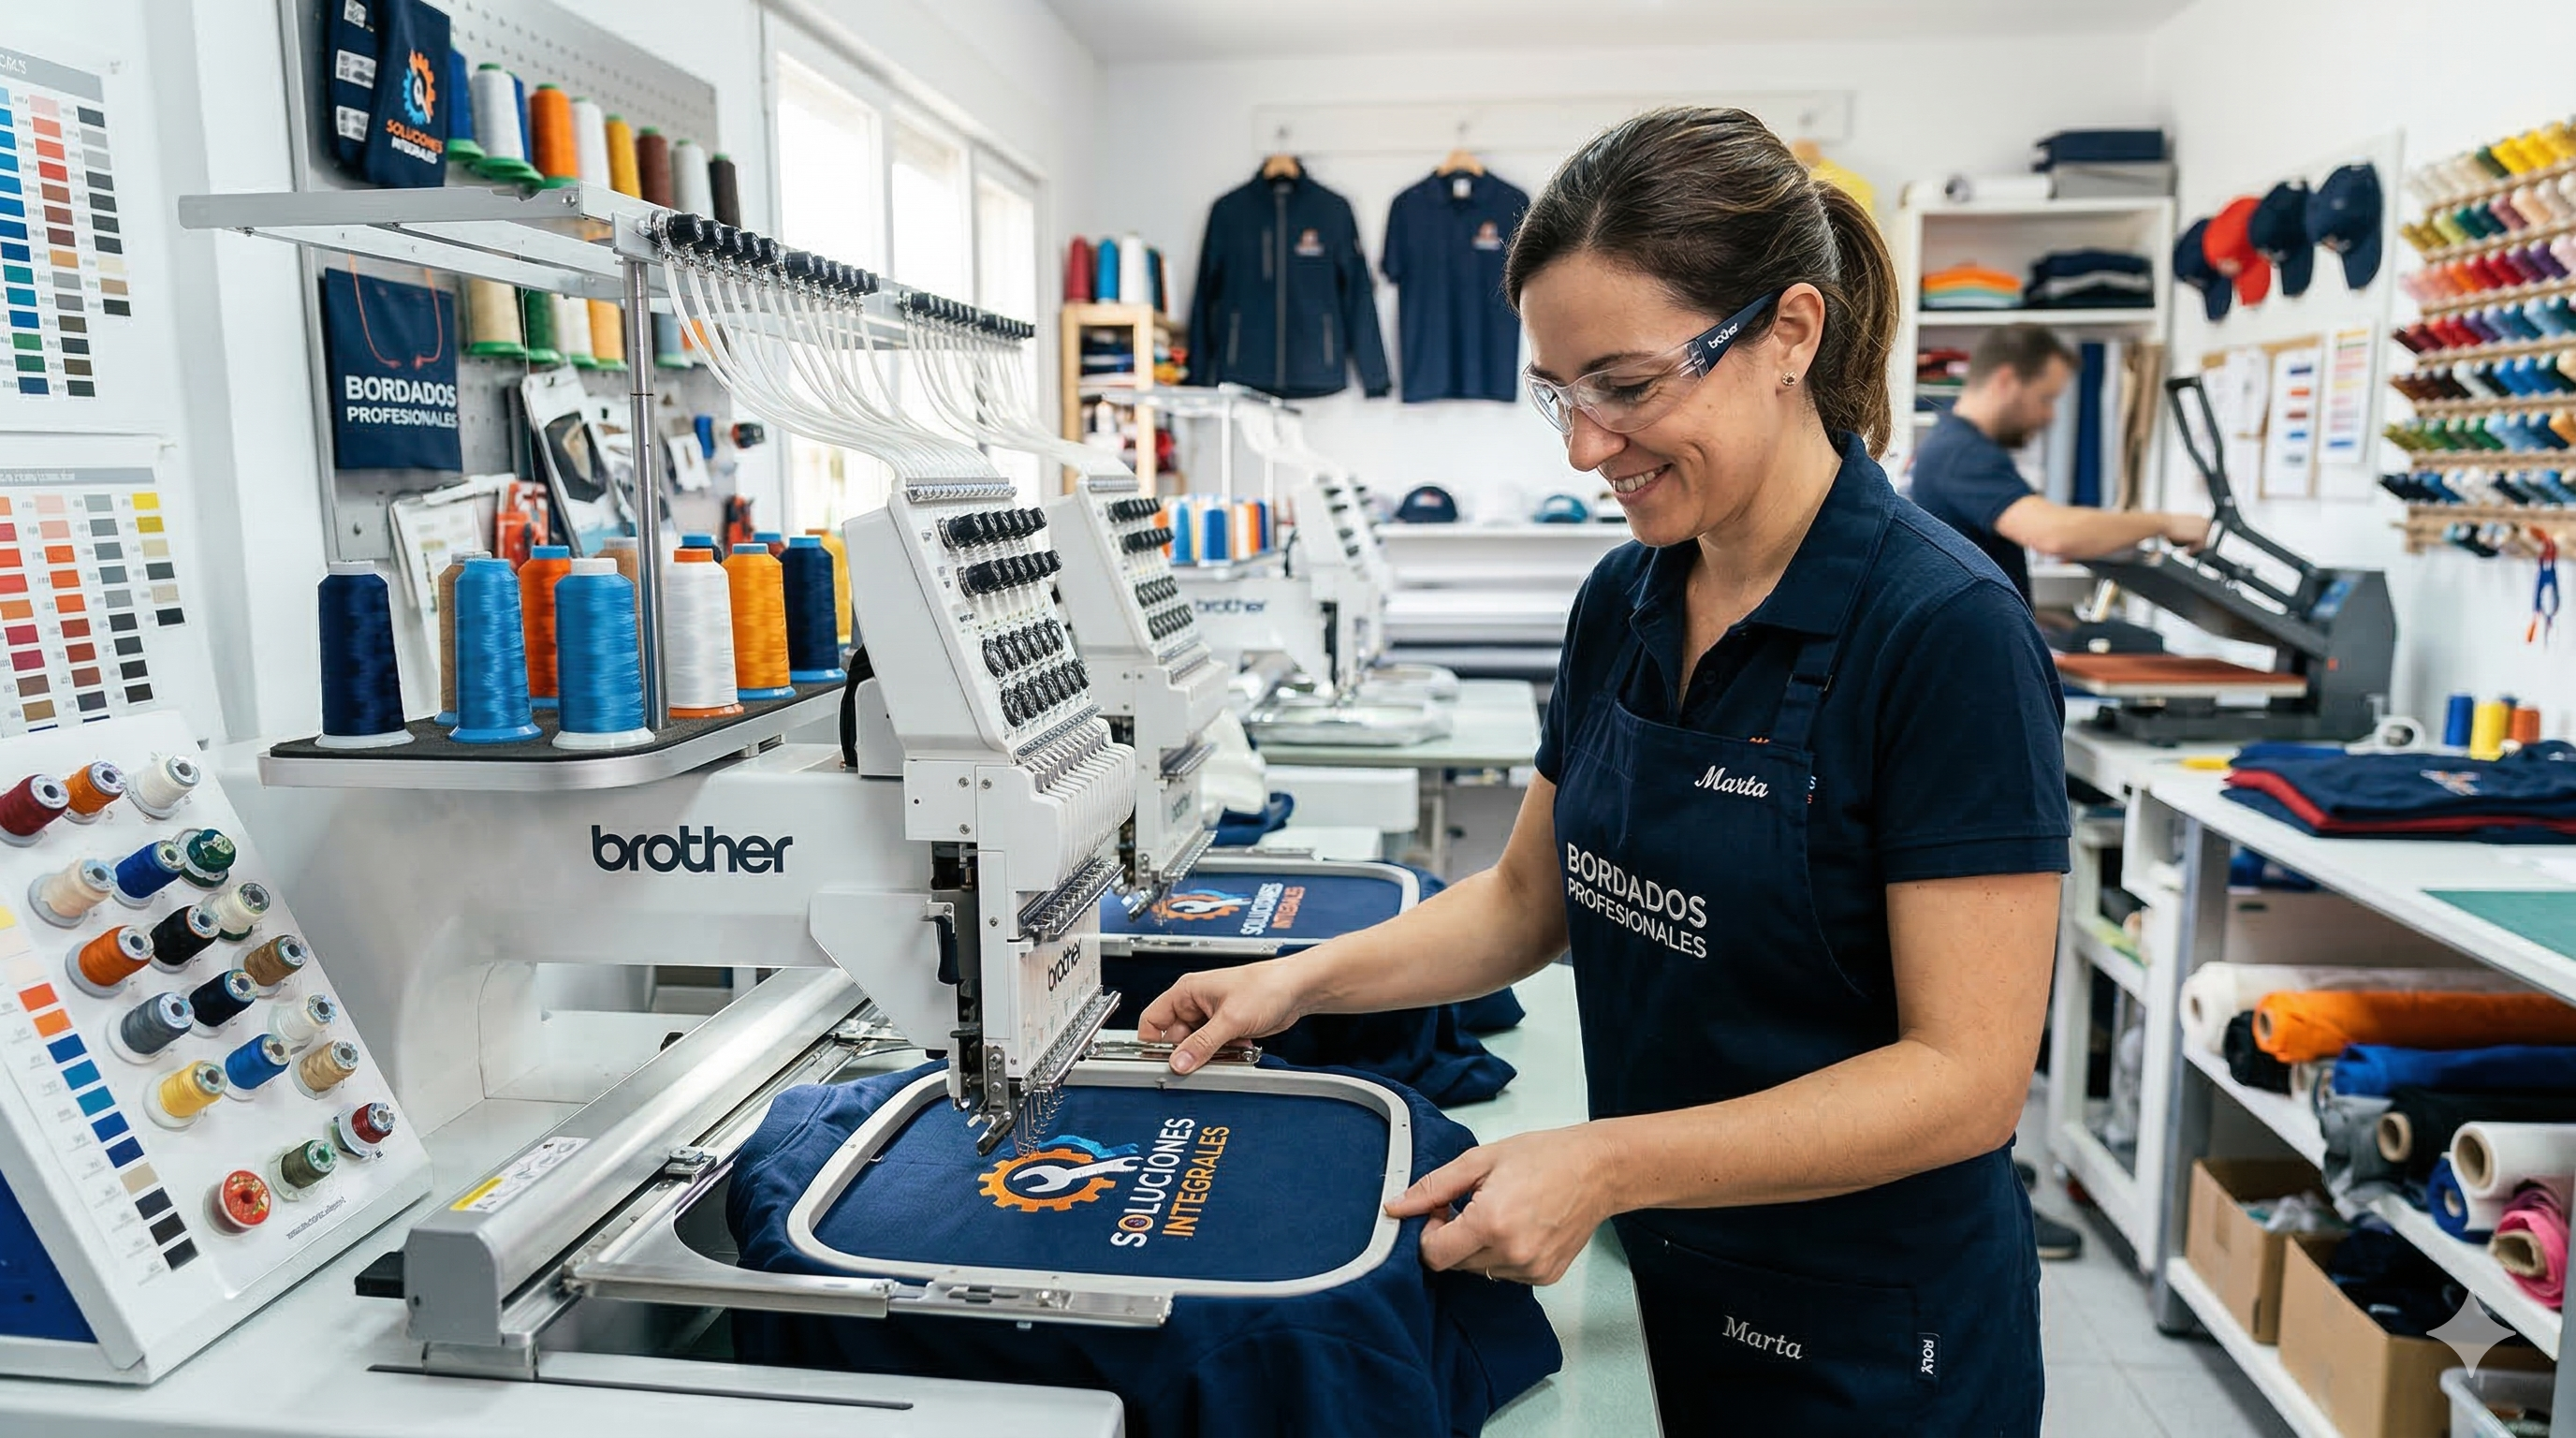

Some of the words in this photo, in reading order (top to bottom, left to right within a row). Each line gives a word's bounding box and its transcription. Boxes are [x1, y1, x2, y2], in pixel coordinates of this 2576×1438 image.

[345, 375, 457, 408] BORDADOS
[346, 406, 458, 429] PROFESIONALES
[1694, 765, 1769, 798] Marta
[591, 824, 794, 873] brother
[1567, 842, 1707, 929] BORDADOS
[1568, 877, 1707, 959] PROFESIONALES
[1047, 937, 1081, 992] brother
[1110, 1118, 1195, 1247] SOLUCIONES
[1162, 1126, 1230, 1237] INTEGRALES
[1722, 1314, 1803, 1360] Marta
[1921, 1339, 1935, 1375] ROLY
